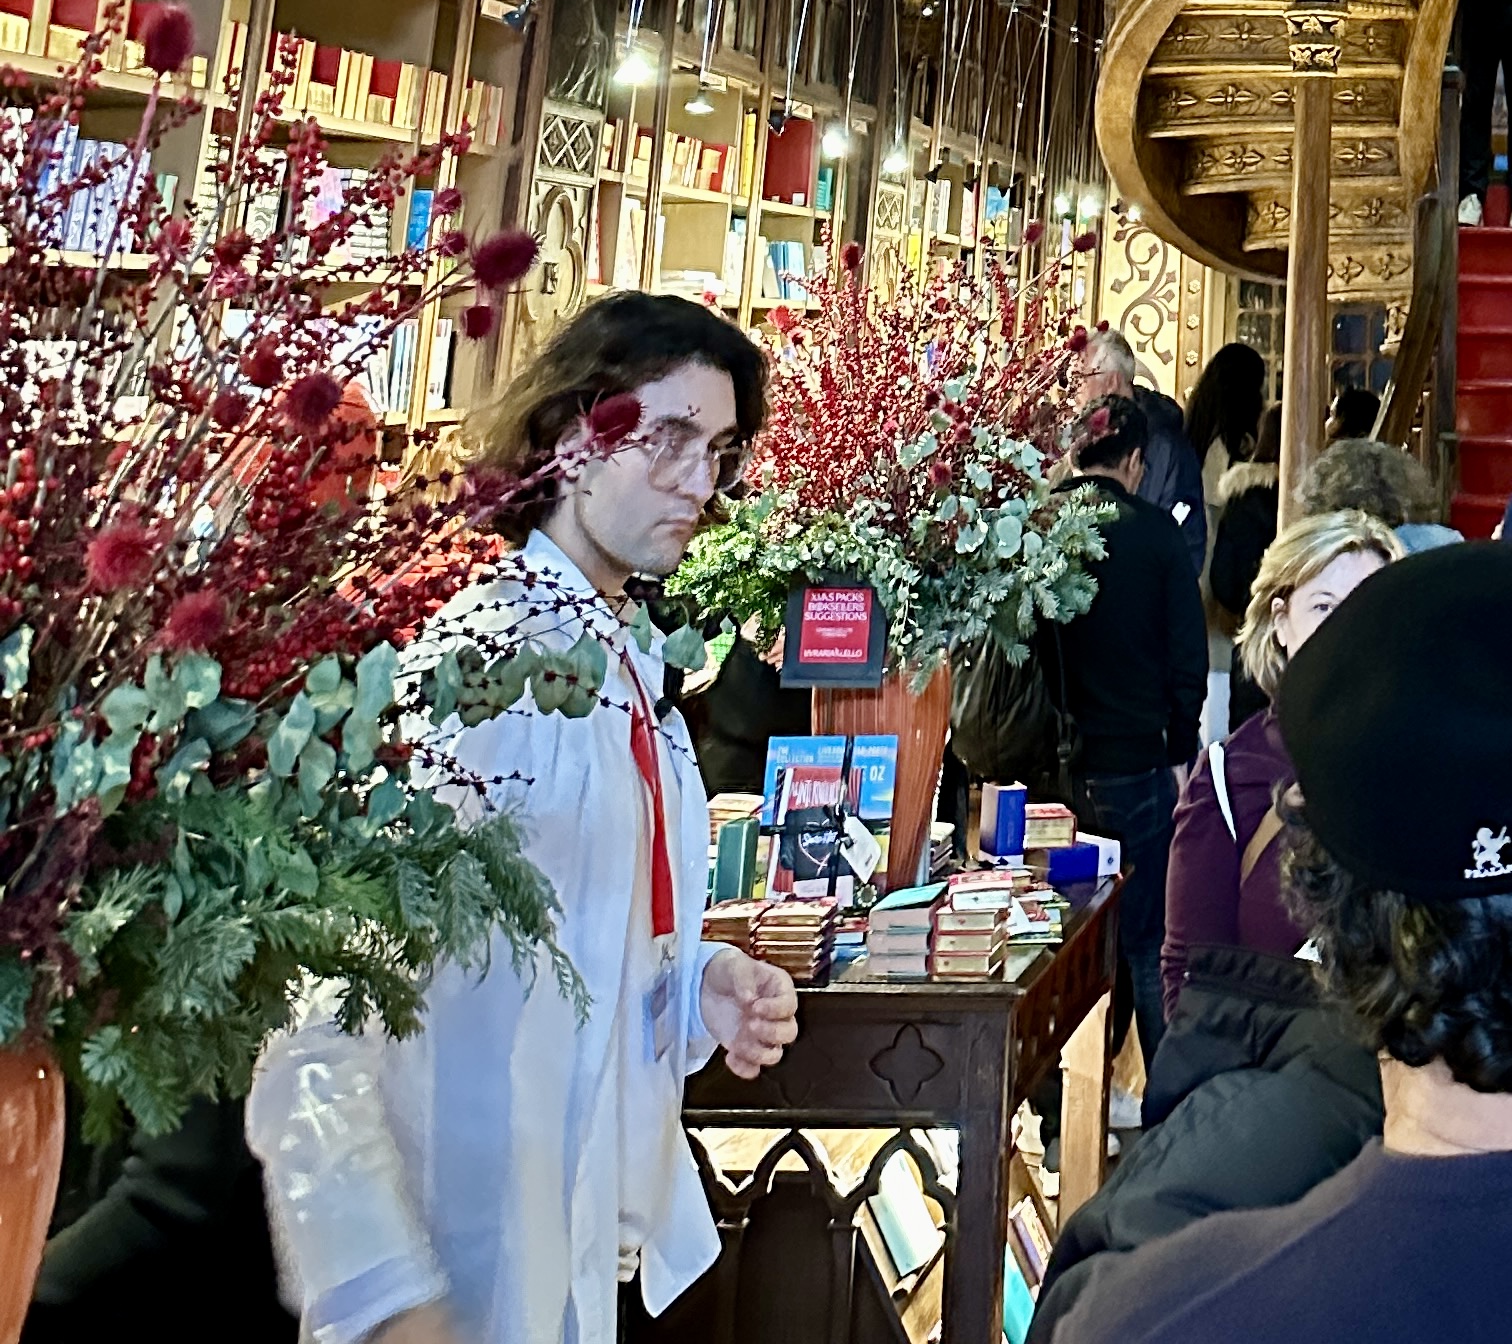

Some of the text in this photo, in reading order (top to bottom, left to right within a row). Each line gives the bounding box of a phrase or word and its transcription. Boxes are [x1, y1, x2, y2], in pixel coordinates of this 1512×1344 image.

[835, 592, 864, 602] PACKS
[807, 602, 865, 611] BOOKSELLERS
[804, 611, 867, 621] SUGGESTIONS
[869, 765, 887, 781] OZ
